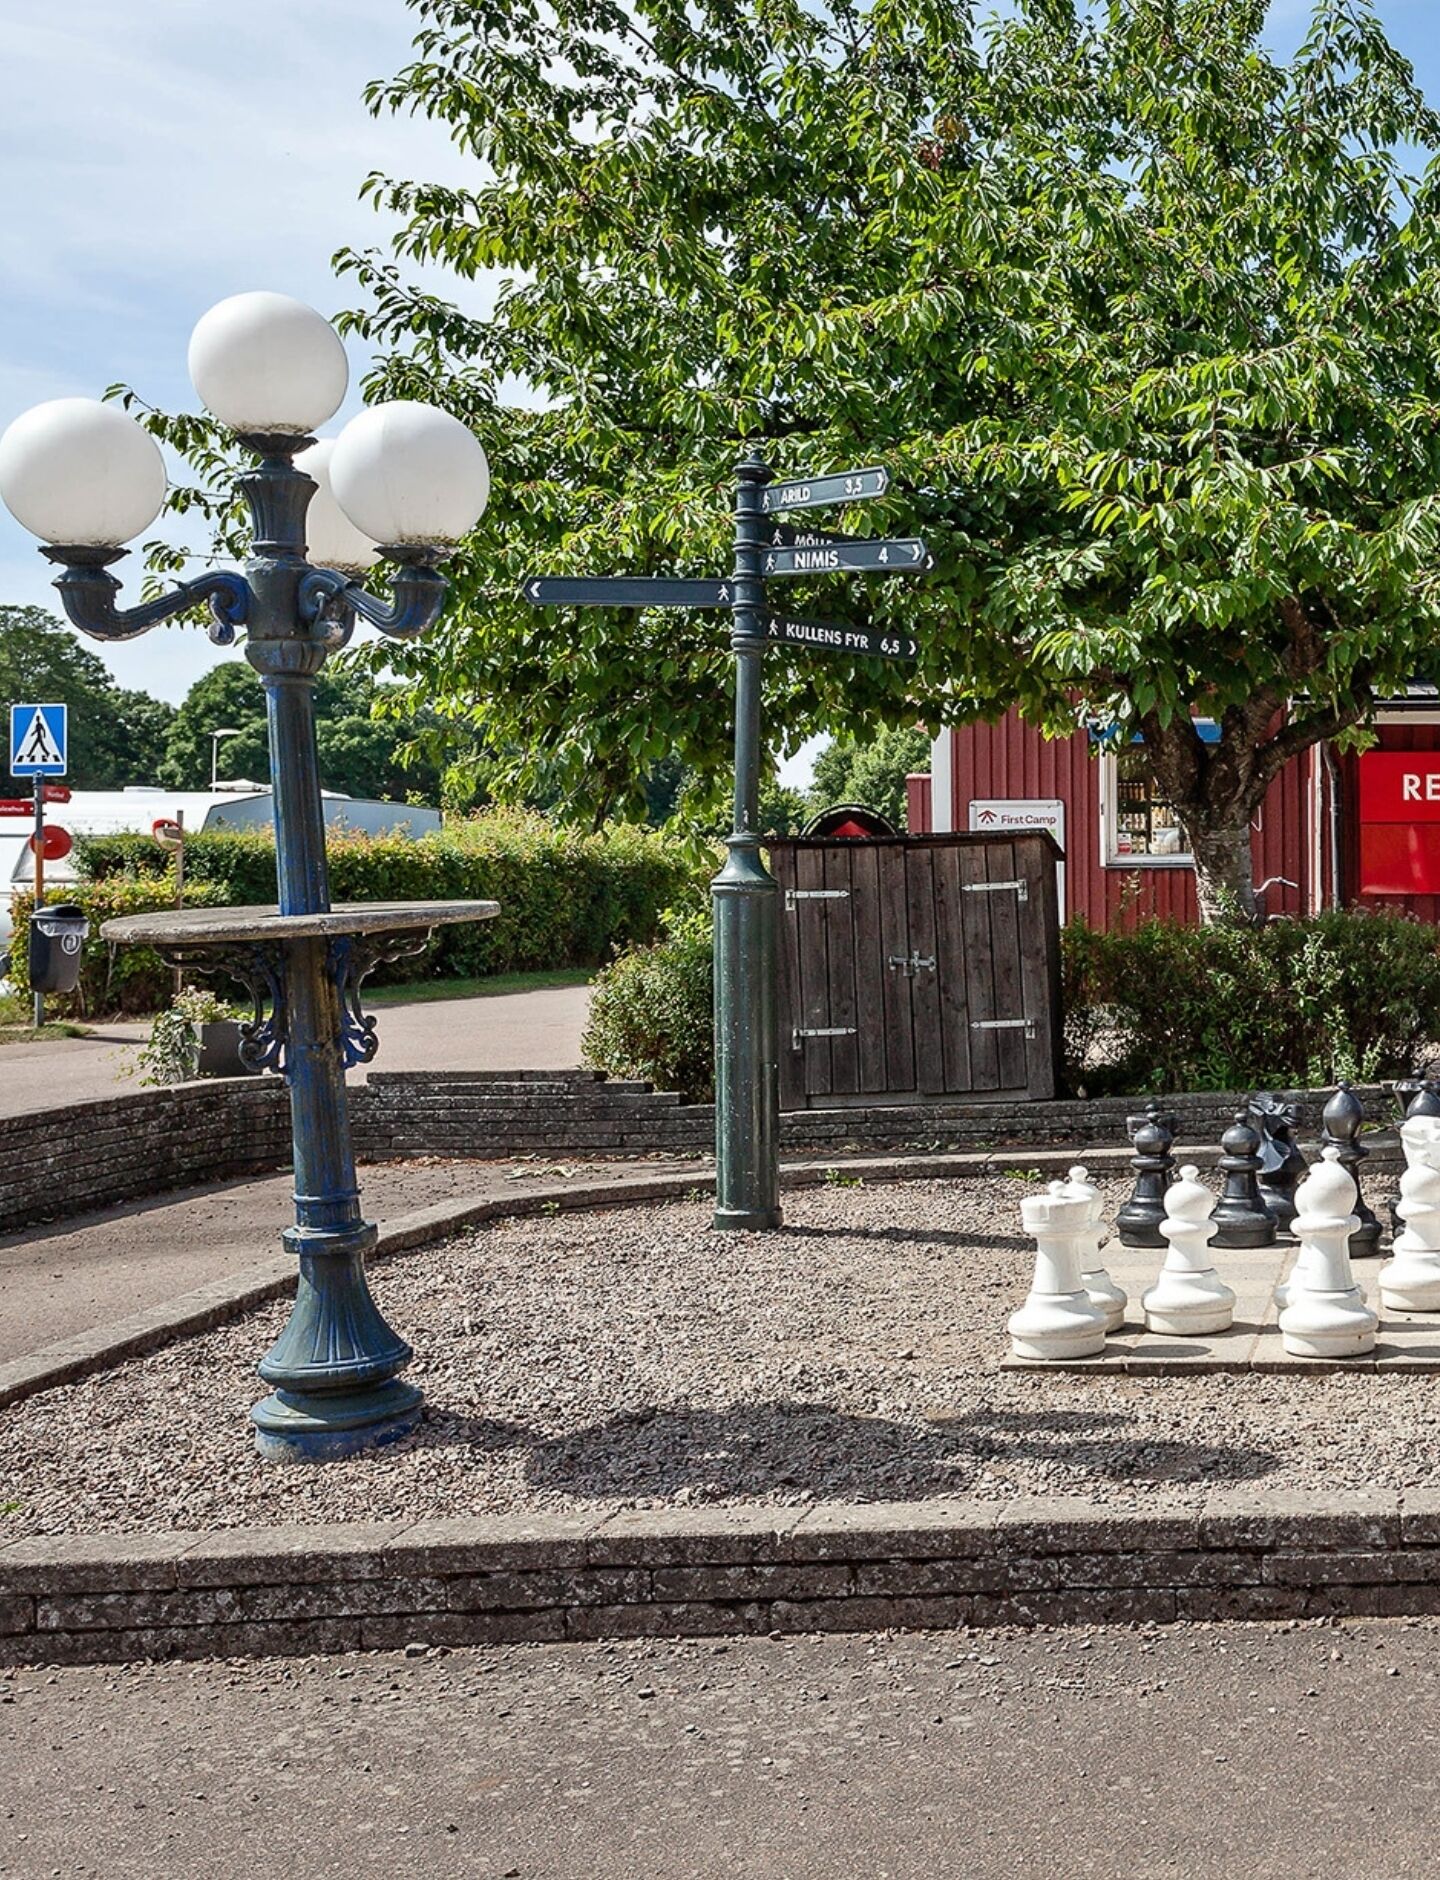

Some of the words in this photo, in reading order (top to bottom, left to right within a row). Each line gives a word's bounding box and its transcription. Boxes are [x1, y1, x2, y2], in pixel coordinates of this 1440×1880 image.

[780, 486, 811, 505] ARILD
[844, 477, 863, 495] 3,5
[794, 533, 834, 547] MÖLL
[794, 551, 839, 569] NIMIS
[878, 547, 888, 563] 4
[786, 623, 842, 645] KULLENS
[845, 633, 869, 649] FYR
[880, 637, 900, 655] 6,5
[1001, 814, 1024, 825] First
[1025, 814, 1057, 826] Camp
